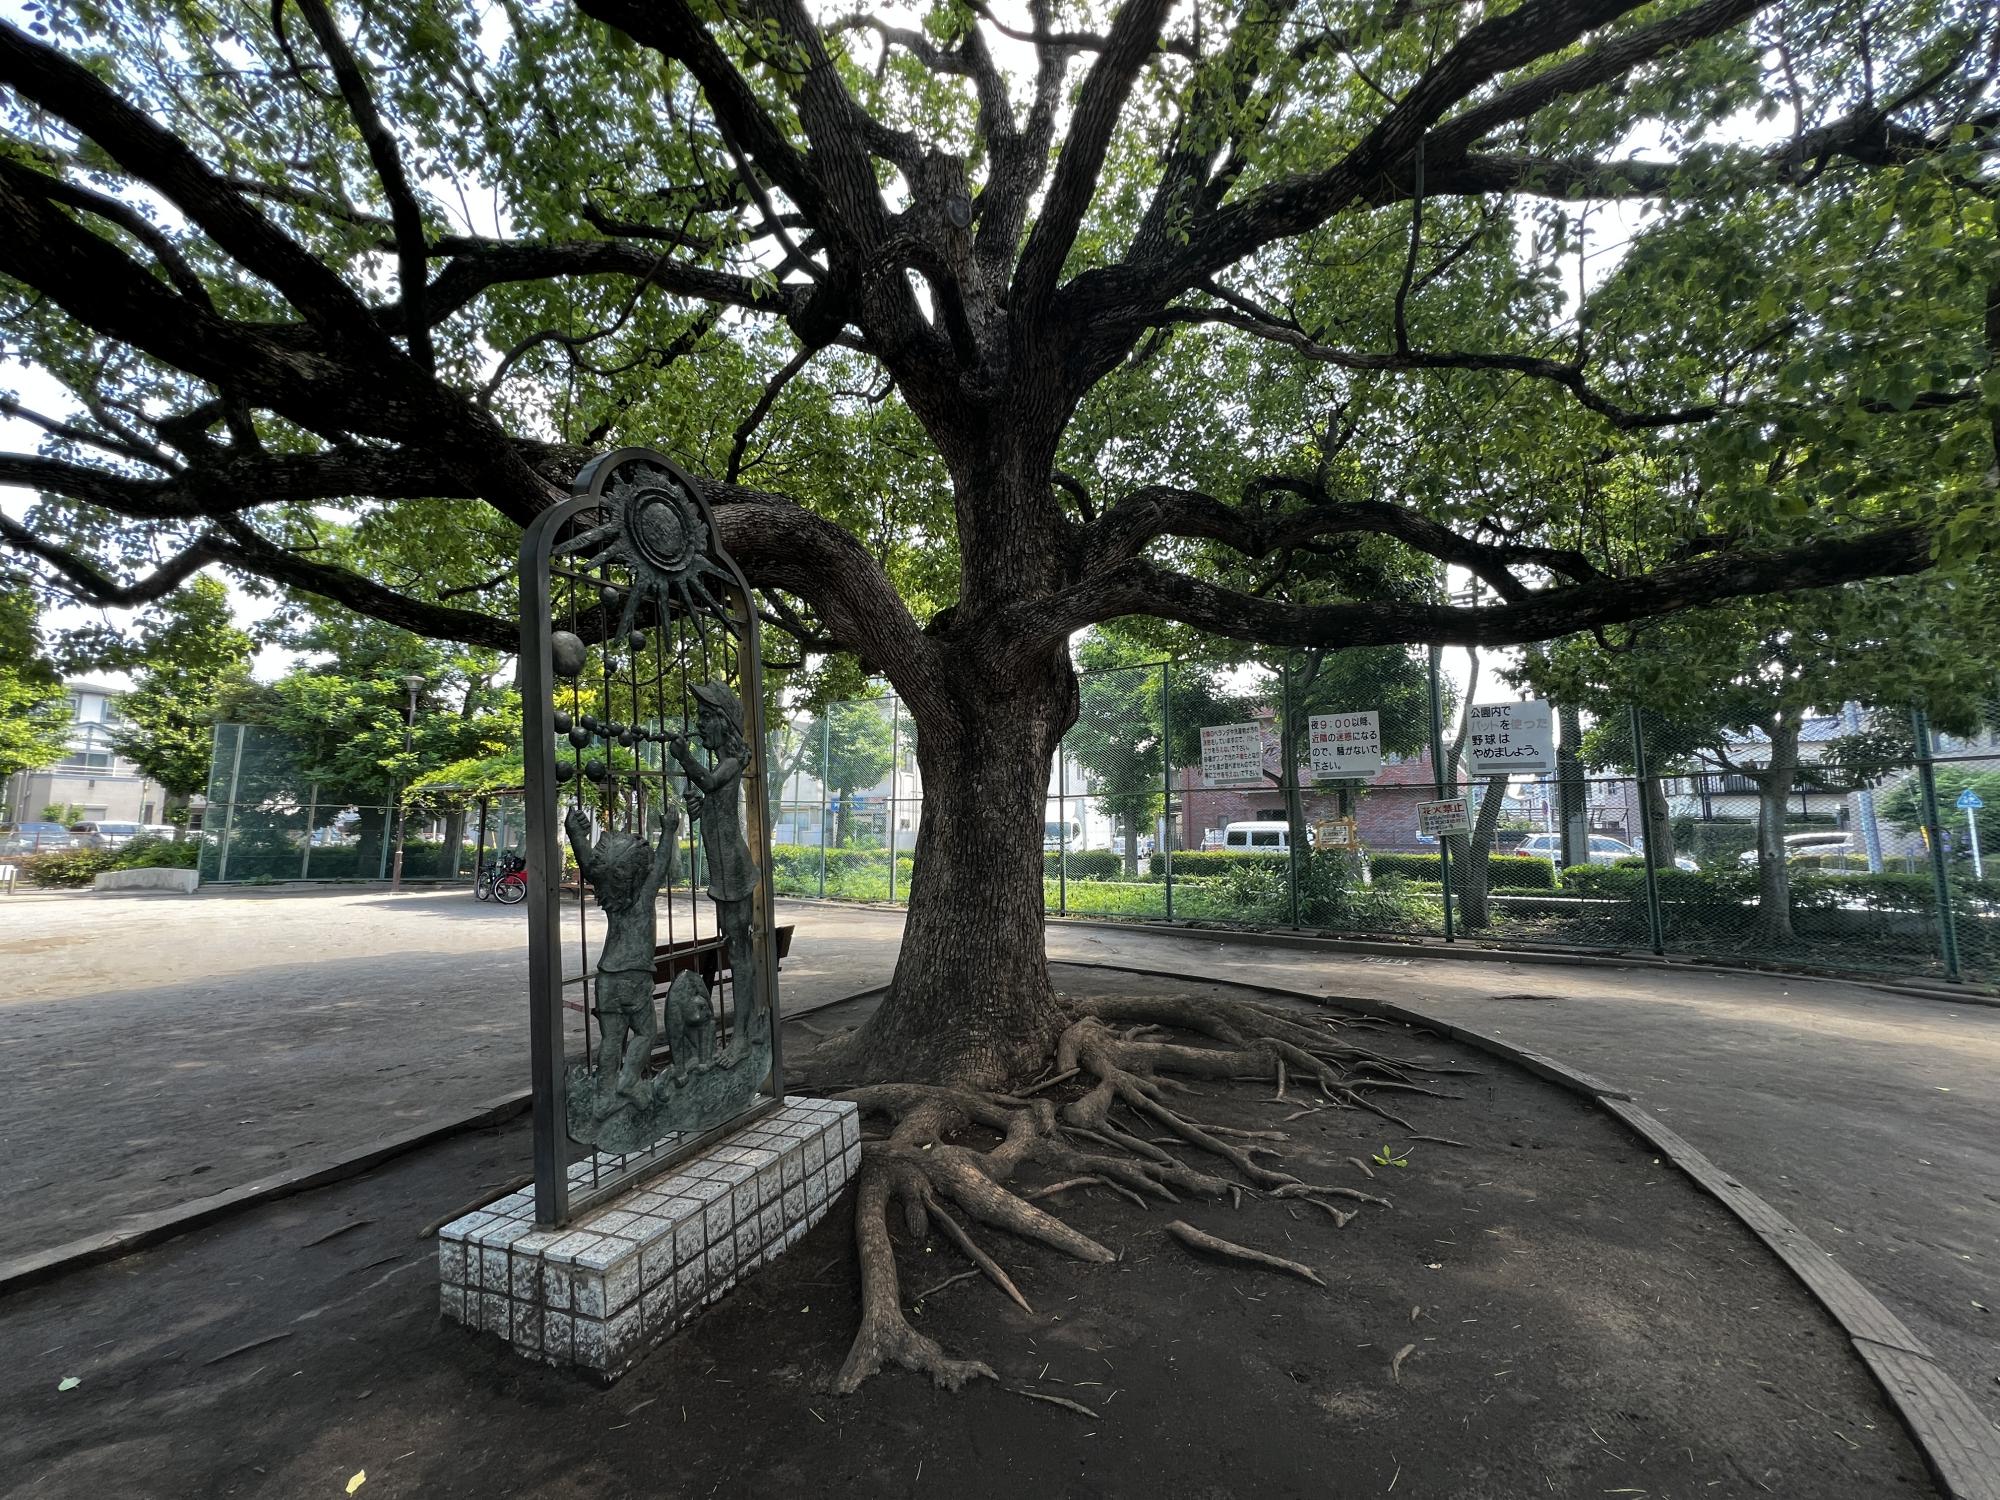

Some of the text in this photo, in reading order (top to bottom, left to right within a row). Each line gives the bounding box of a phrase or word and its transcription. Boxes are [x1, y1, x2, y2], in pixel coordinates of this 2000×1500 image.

[1471, 706, 1511, 718] 公園内で
[1472, 734, 1511, 746] 野球は
[1473, 745, 1539, 758] やめましょう。
[1313, 761, 1342, 771] 下さい。
[1421, 803, 1465, 815] 花火禁止
